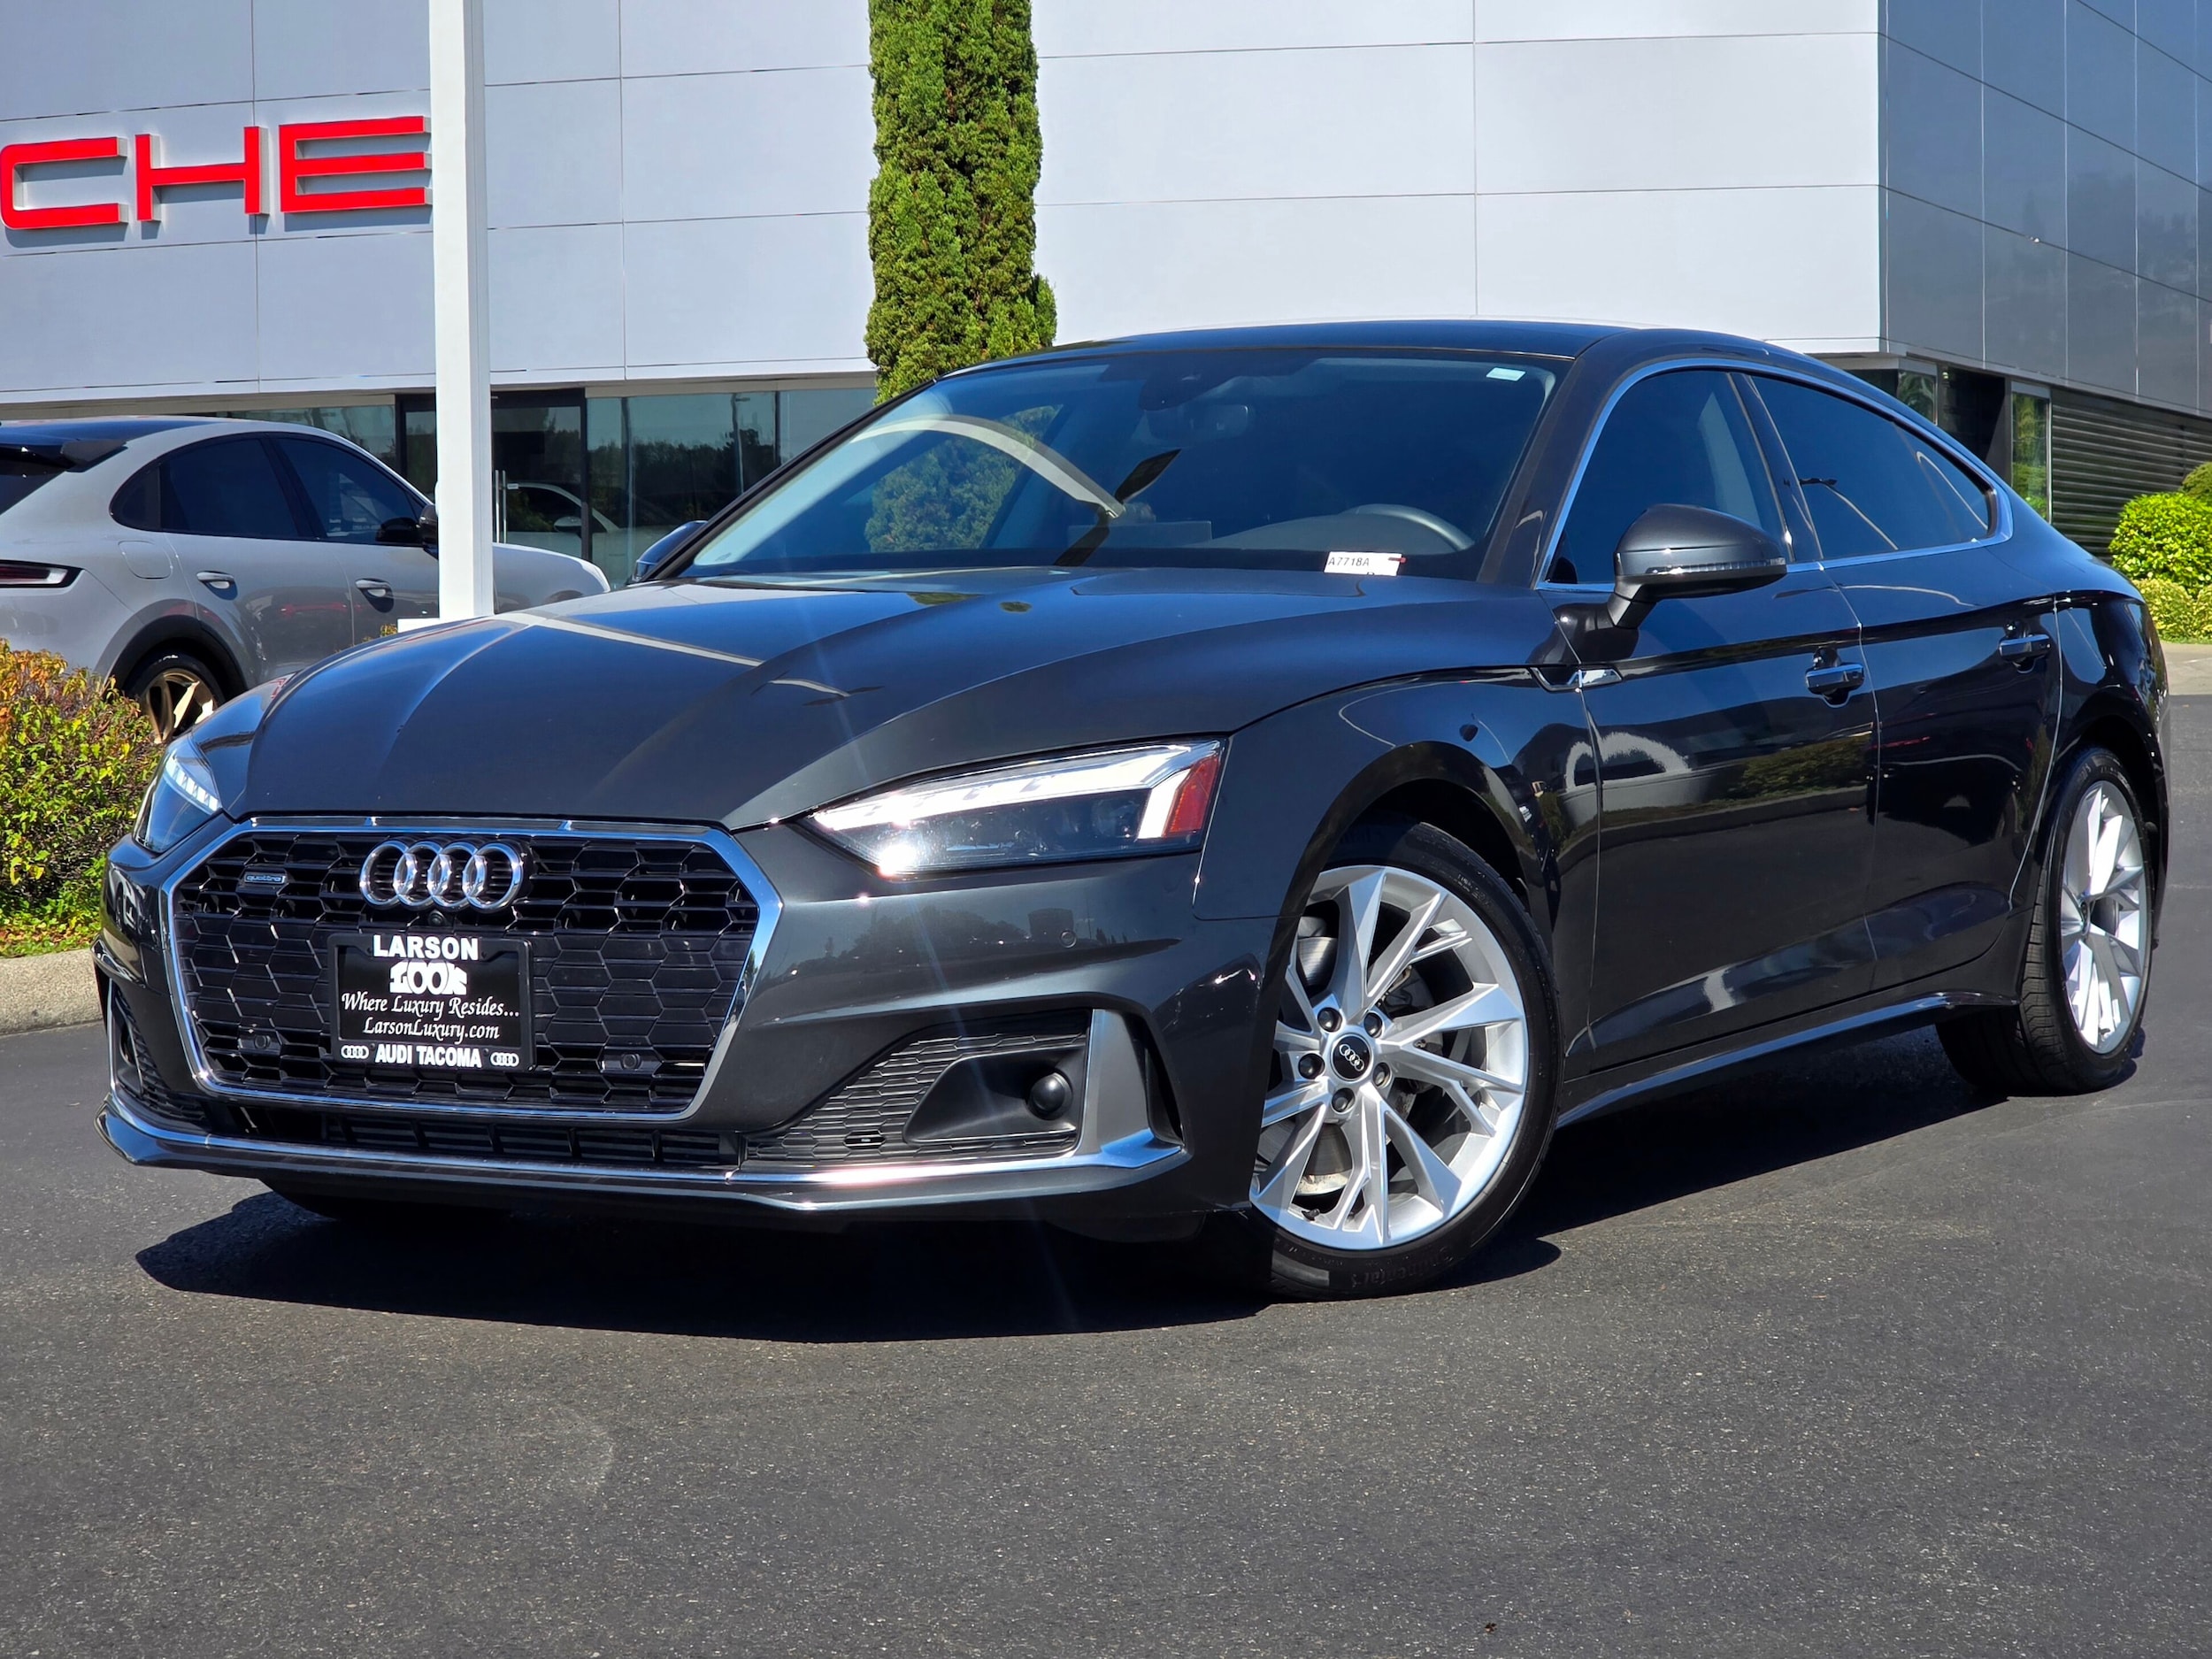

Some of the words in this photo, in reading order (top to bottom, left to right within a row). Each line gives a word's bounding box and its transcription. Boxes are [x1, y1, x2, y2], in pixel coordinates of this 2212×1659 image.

[0, 116, 432, 230] CHE
[1327, 557, 1371, 567] A7718A
[373, 934, 479, 961] LARSON
[341, 991, 388, 1012] Where
[390, 995, 445, 1022] Luxury
[448, 996, 520, 1019] Resides...
[363, 1017, 501, 1045] LarsonLuxury.com
[375, 1044, 413, 1065] AUDI
[416, 1046, 483, 1069] TACOMA
